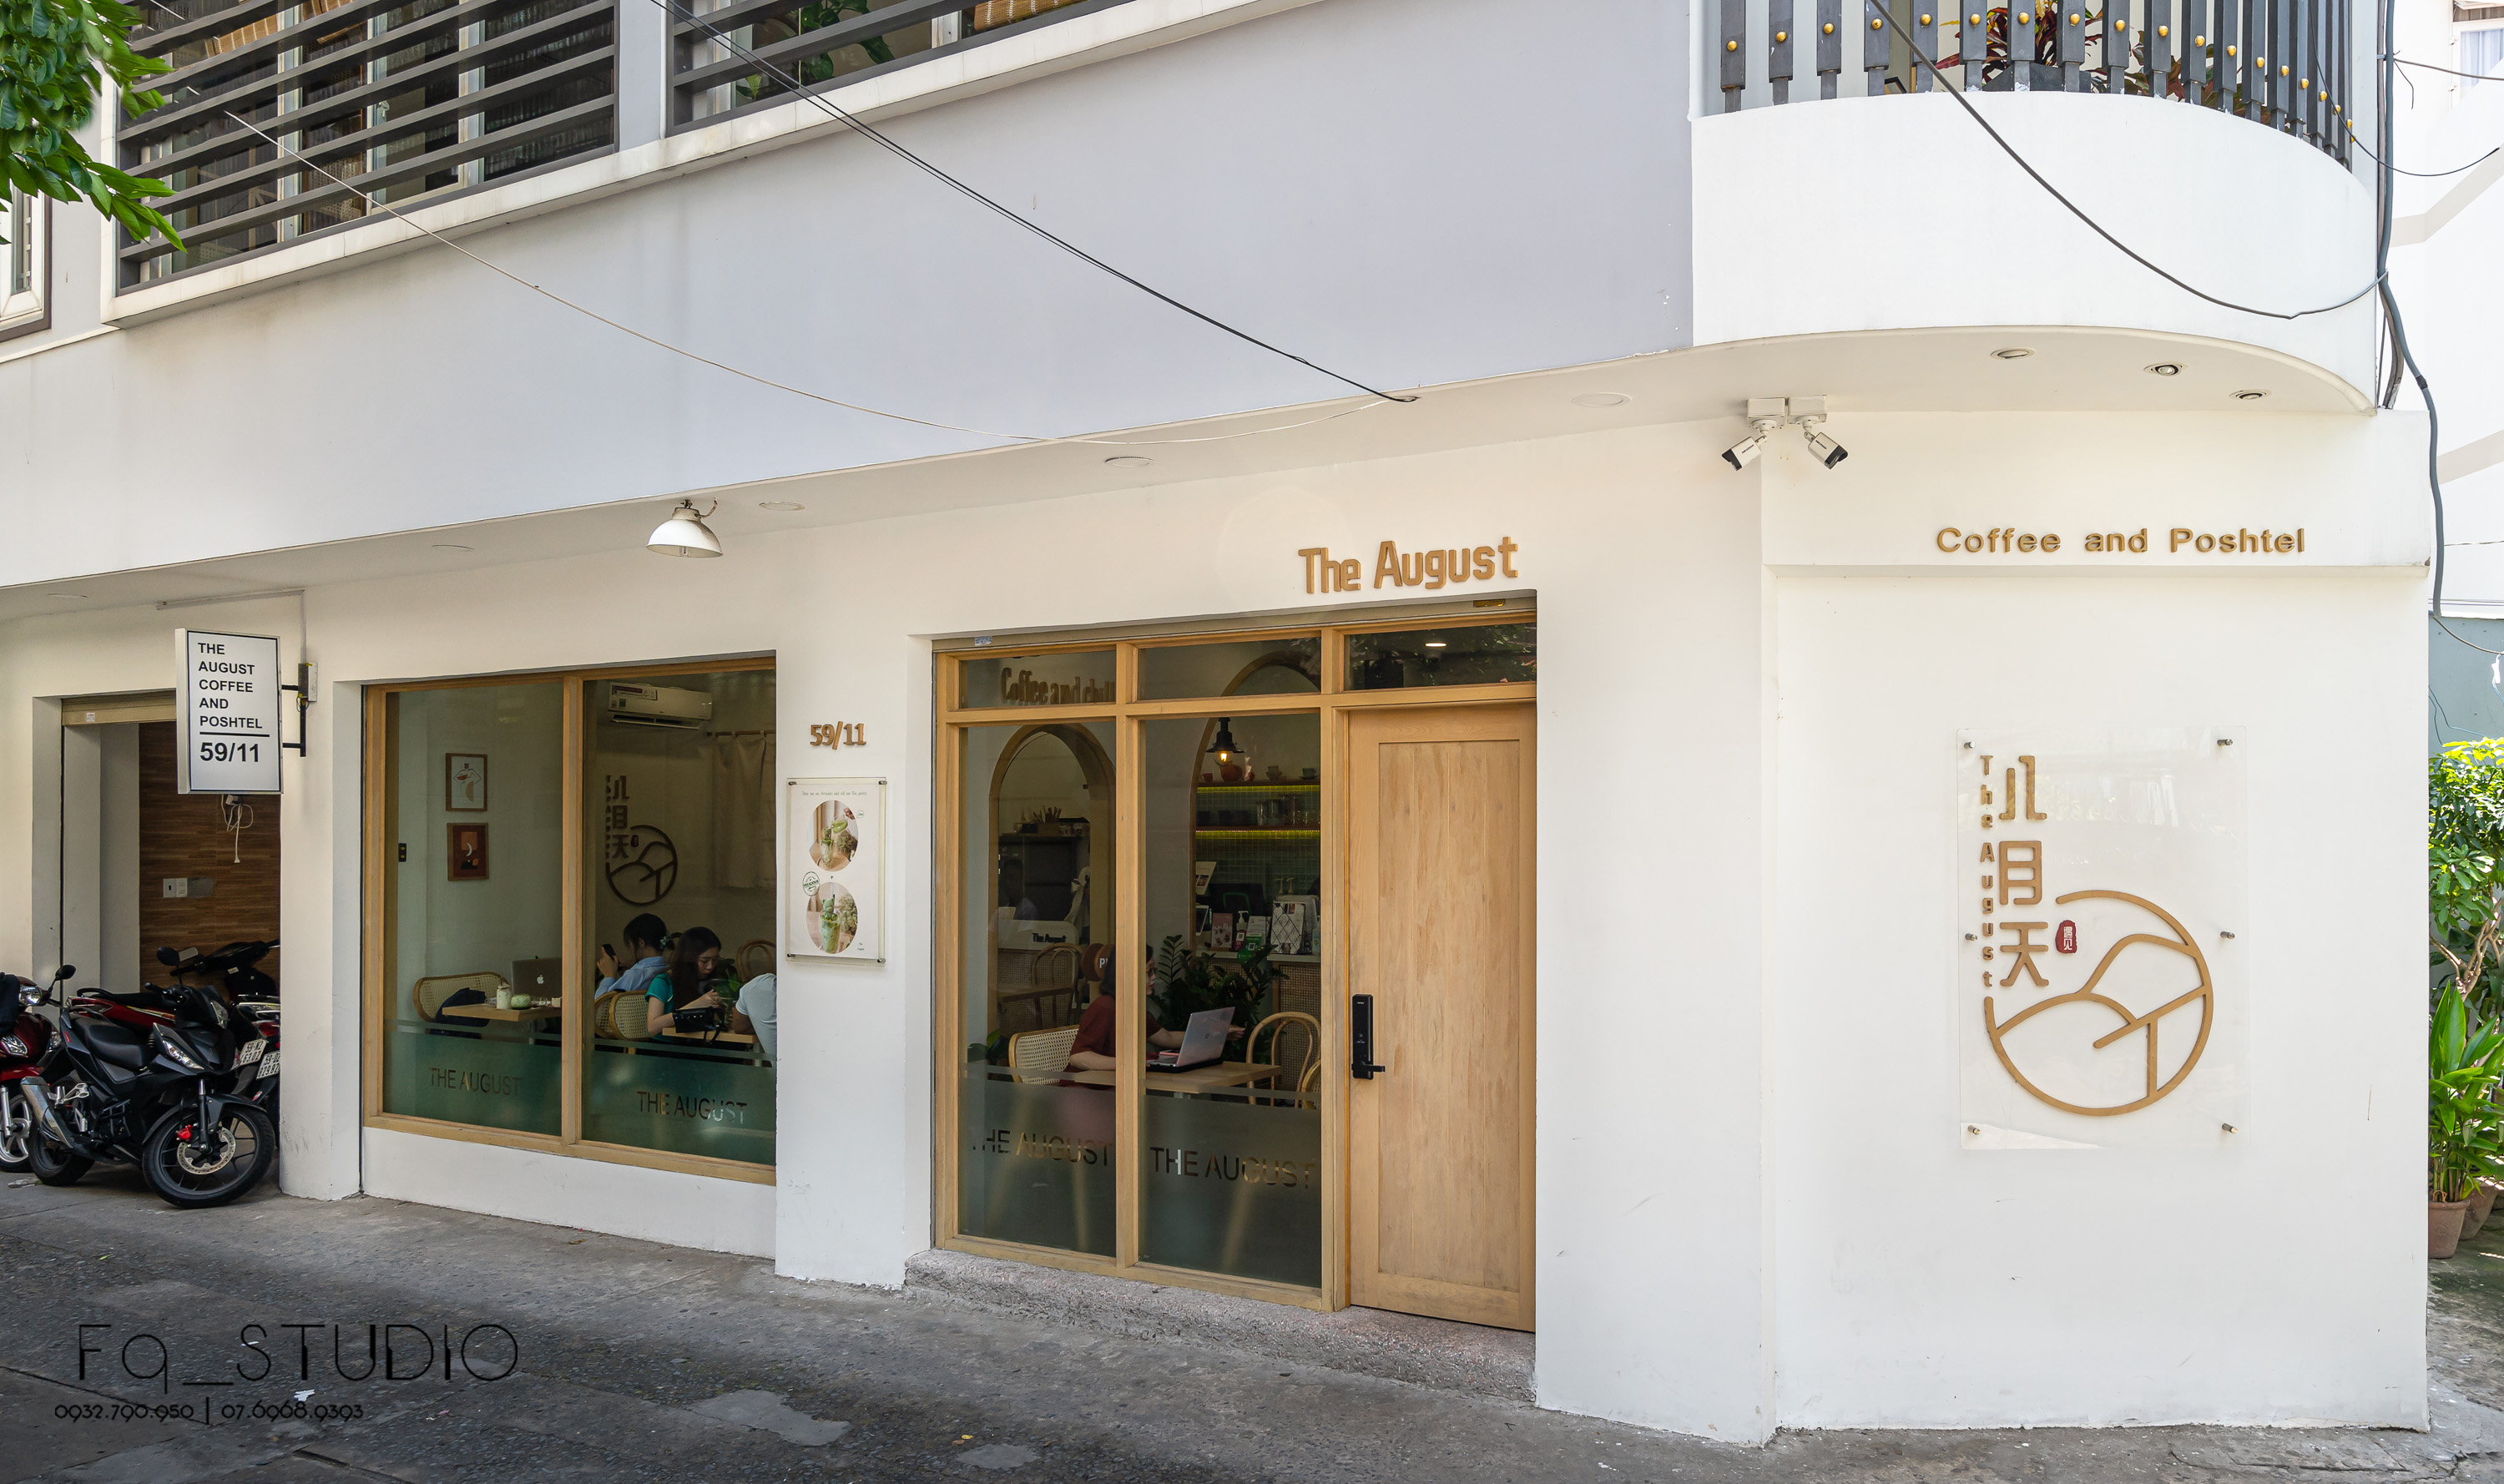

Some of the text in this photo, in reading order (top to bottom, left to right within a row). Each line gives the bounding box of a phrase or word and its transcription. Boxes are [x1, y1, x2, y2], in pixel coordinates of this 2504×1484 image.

[1936, 527, 2305, 553] Coffee and Poshtel
[1298, 537, 1518, 593] The August
[198, 642, 225, 655] THE
[198, 661, 255, 675] AUGUST
[199, 679, 254, 693] COFFEE
[199, 698, 229, 709] AND
[199, 715, 263, 729] POSHTEL
[810, 721, 866, 750] 59/11
[199, 741, 259, 763] 59/11
[1980, 755, 1995, 987] The August
[429, 1067, 521, 1096] THE AUGUST
[637, 1091, 747, 1124] THE AUGUST
[1016, 1132, 1112, 1166] AUGUST
[1150, 1147, 1315, 1189] THE AUGUST
